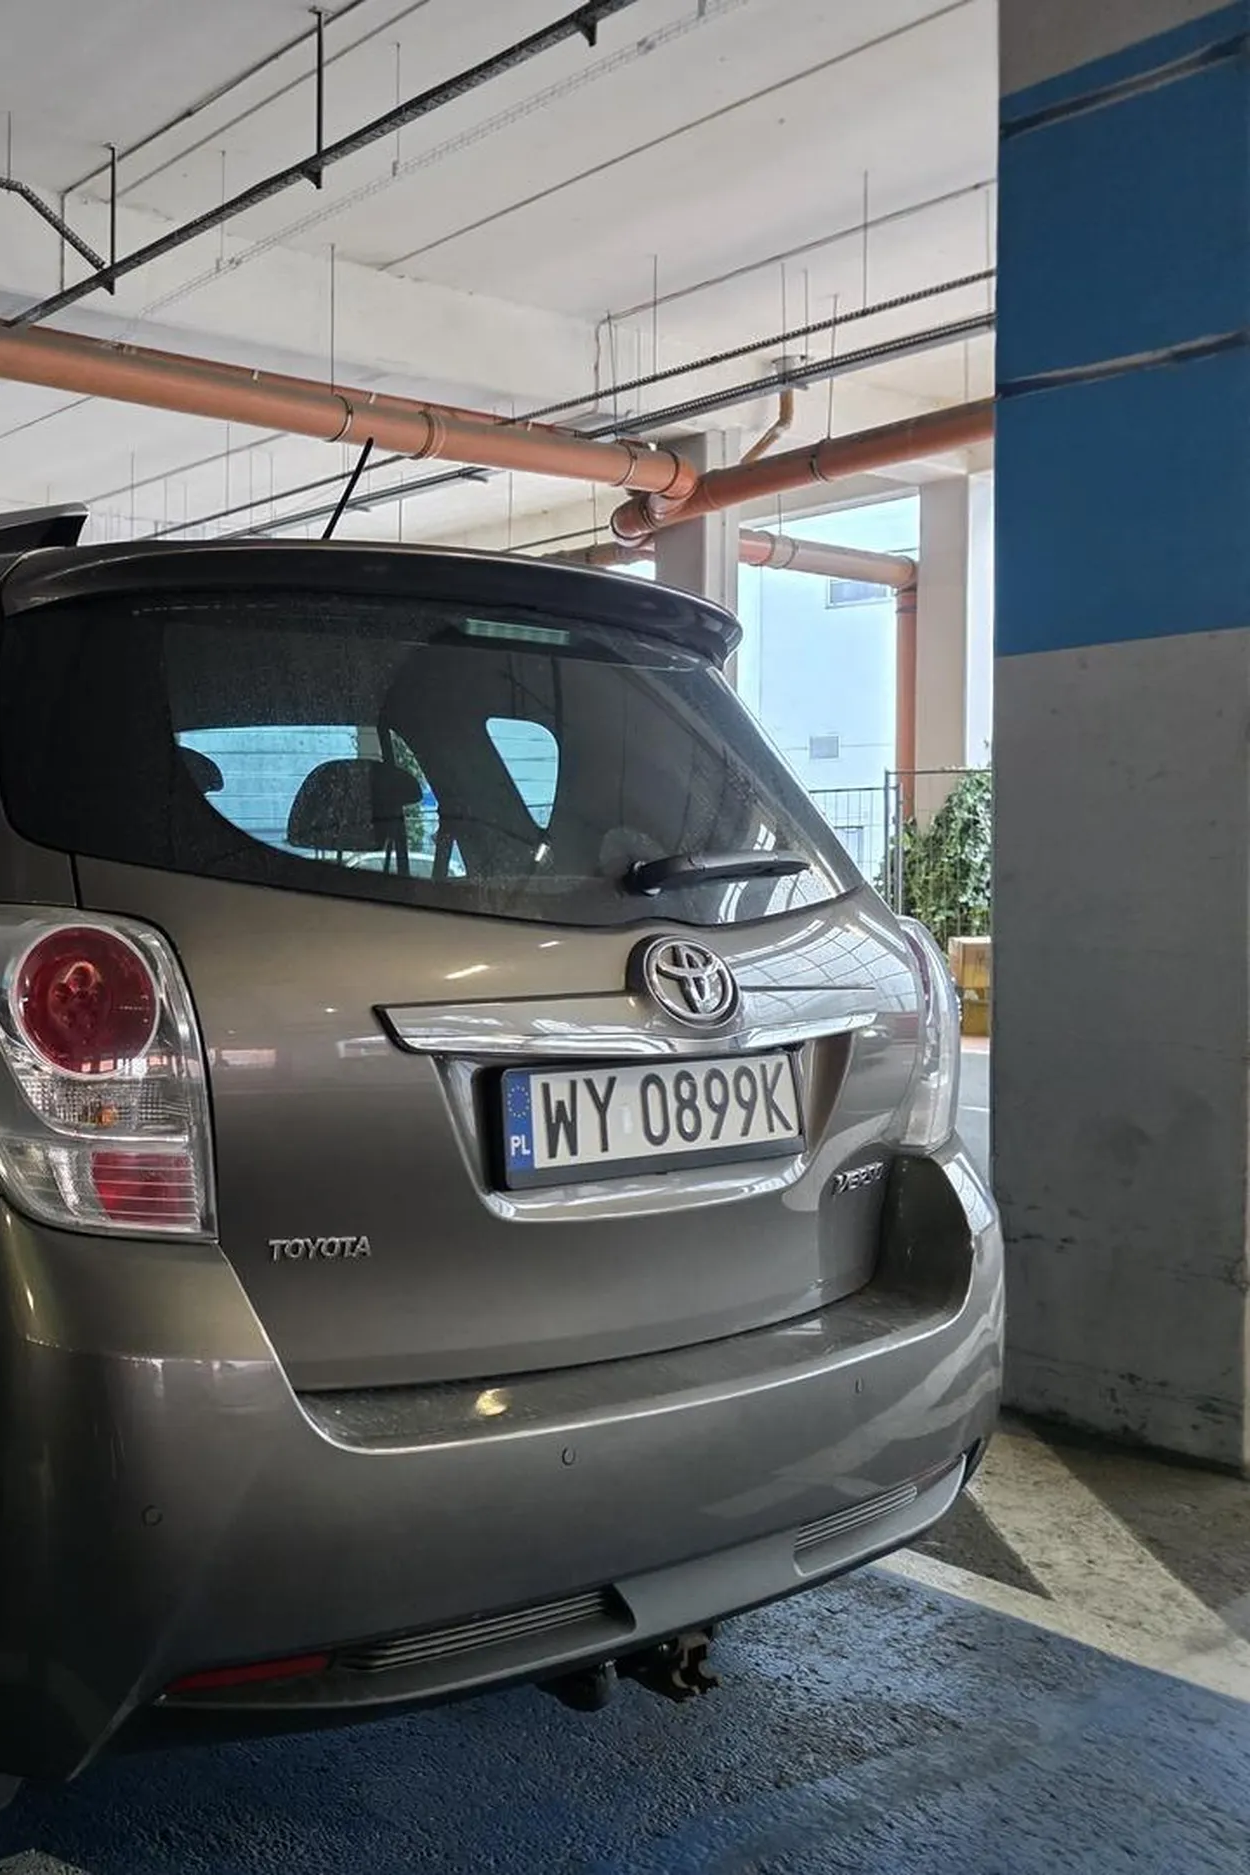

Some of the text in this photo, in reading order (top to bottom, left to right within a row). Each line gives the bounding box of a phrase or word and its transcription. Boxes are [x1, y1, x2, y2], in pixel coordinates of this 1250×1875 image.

[541, 1061, 793, 1160] WY 0899K
[510, 1134, 531, 1157] PL
[268, 1235, 371, 1261] TOYOTA
